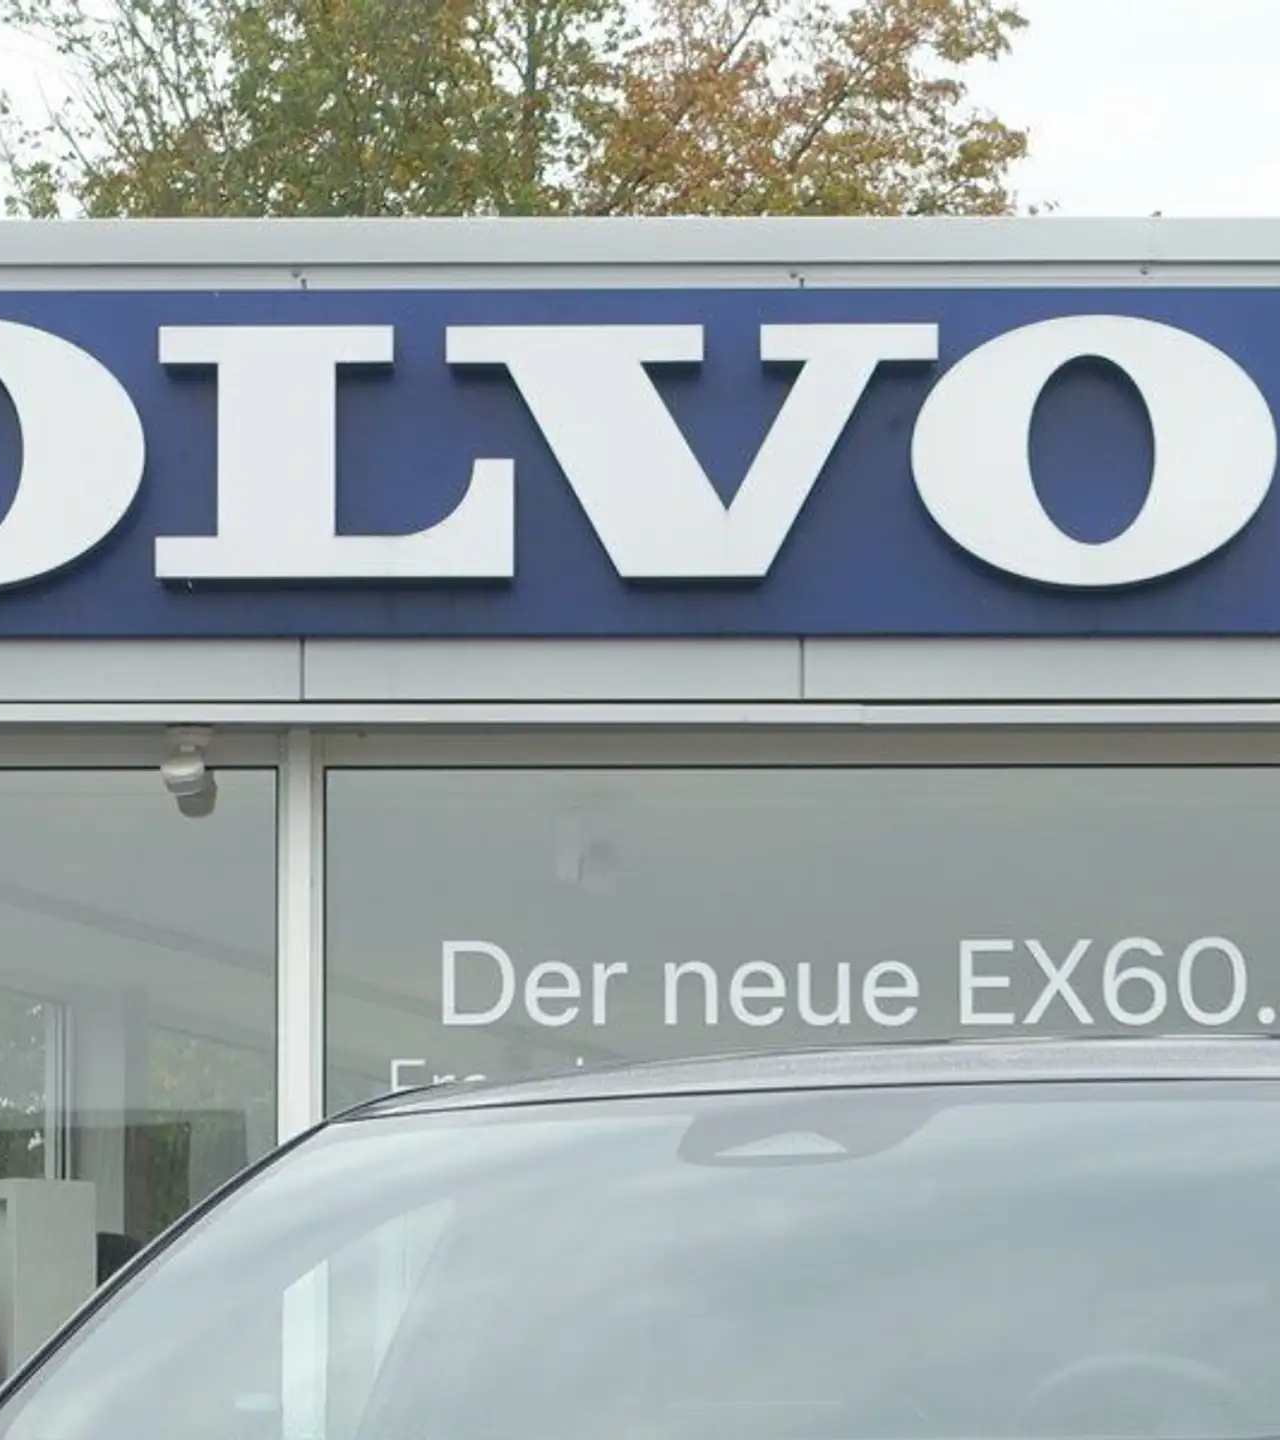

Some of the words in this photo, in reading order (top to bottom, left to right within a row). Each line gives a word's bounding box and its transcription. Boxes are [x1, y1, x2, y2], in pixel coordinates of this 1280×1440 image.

[440, 940, 629, 1026] Der
[663, 957, 919, 1026] neue
[959, 936, 1276, 1026] EX60.
